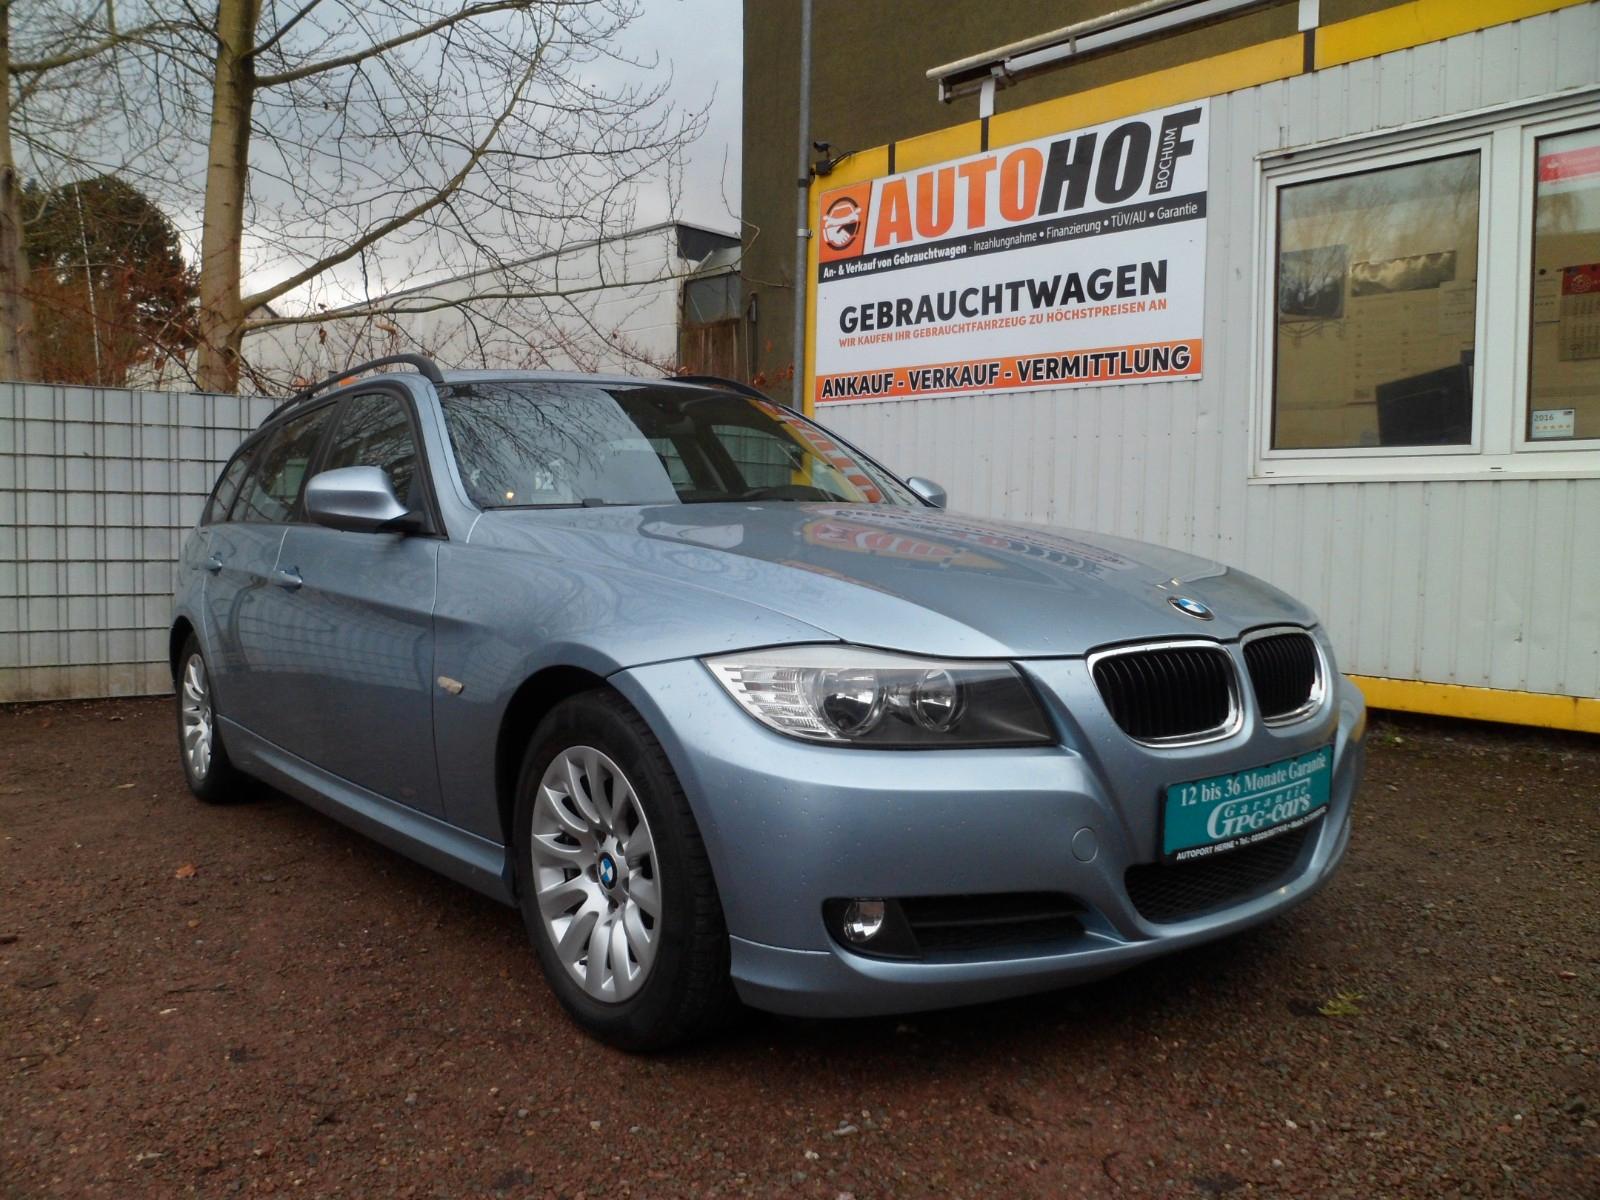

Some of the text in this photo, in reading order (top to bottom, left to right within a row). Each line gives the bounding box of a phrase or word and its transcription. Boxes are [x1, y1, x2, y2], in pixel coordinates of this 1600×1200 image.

[874, 107, 1203, 247] AUTOHOF
[1155, 128, 1177, 189] BOCHUM
[823, 267, 837, 279] An-
[838, 264, 845, 275] &
[846, 257, 877, 274] Verkauf
[877, 259, 892, 269] von
[893, 244, 967, 265] Gebrauchtwagen
[973, 231, 1037, 251] Inzahlungnahme
[1046, 222, 1101, 239] Finanzierung
[1111, 210, 1146, 228] TÜV/AU
[1157, 202, 1198, 219] Garantie
[838, 299, 1168, 348] WIR KAUFEN IHR GEBRAUCHTFAHRZEUG ZU HÖCHSTPREISEN AN
[839, 259, 1168, 334] GEBRAUCHTWAGEN
[821, 376, 894, 399] ANKAUF
[908, 362, 1001, 391] VERKAUF
[1016, 345, 1191, 382] VERMITTLUNG
[1180, 755, 1326, 807] 12 bis 36 Monate Garantie
[1176, 845, 1213, 861] AUTOPORT
